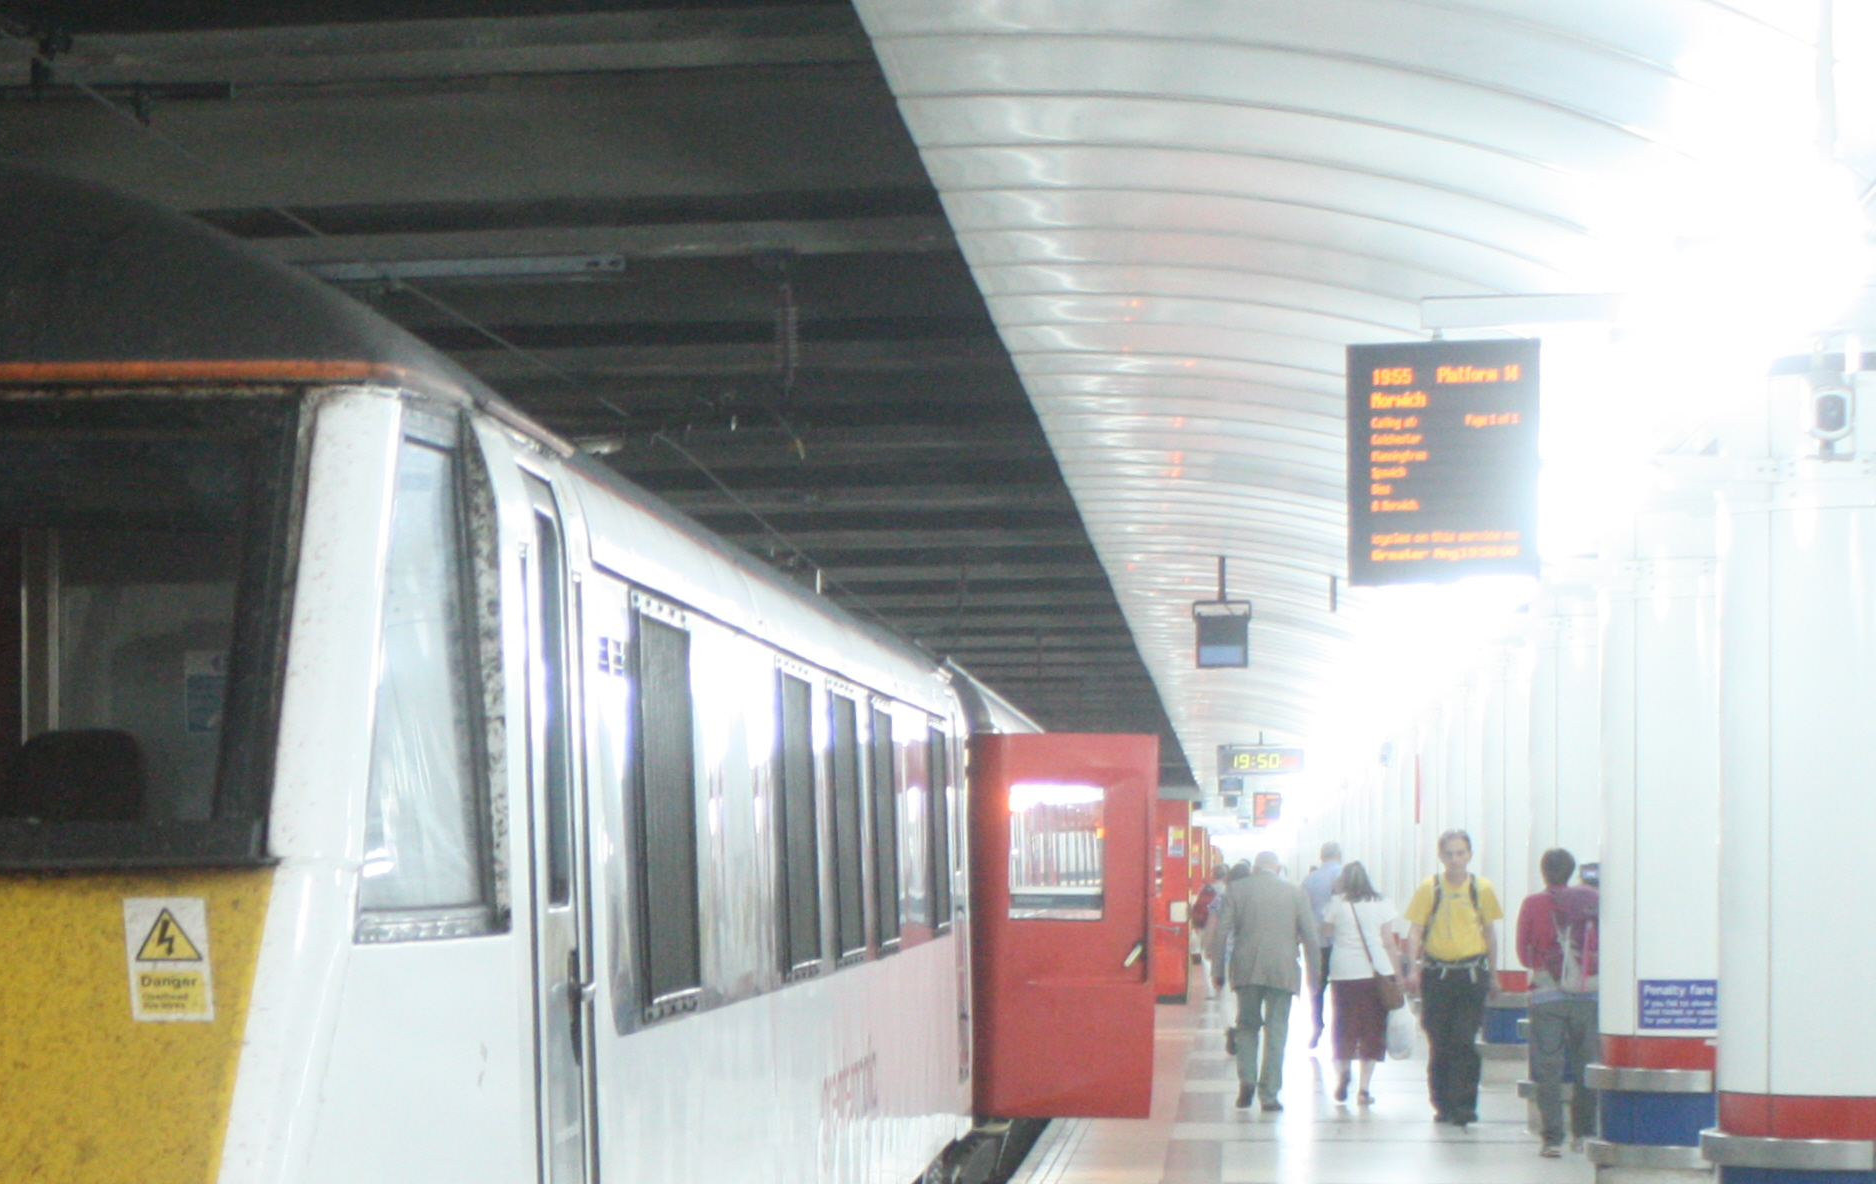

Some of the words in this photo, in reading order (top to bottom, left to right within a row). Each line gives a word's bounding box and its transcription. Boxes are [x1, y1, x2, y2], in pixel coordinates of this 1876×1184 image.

[1436, 365, 1500, 384] Platform
[1370, 391, 1428, 409] Norwich
[1234, 753, 1281, 769] 19:50
[140, 975, 197, 989] Danger
[1643, 984, 1687, 998] Penalty
